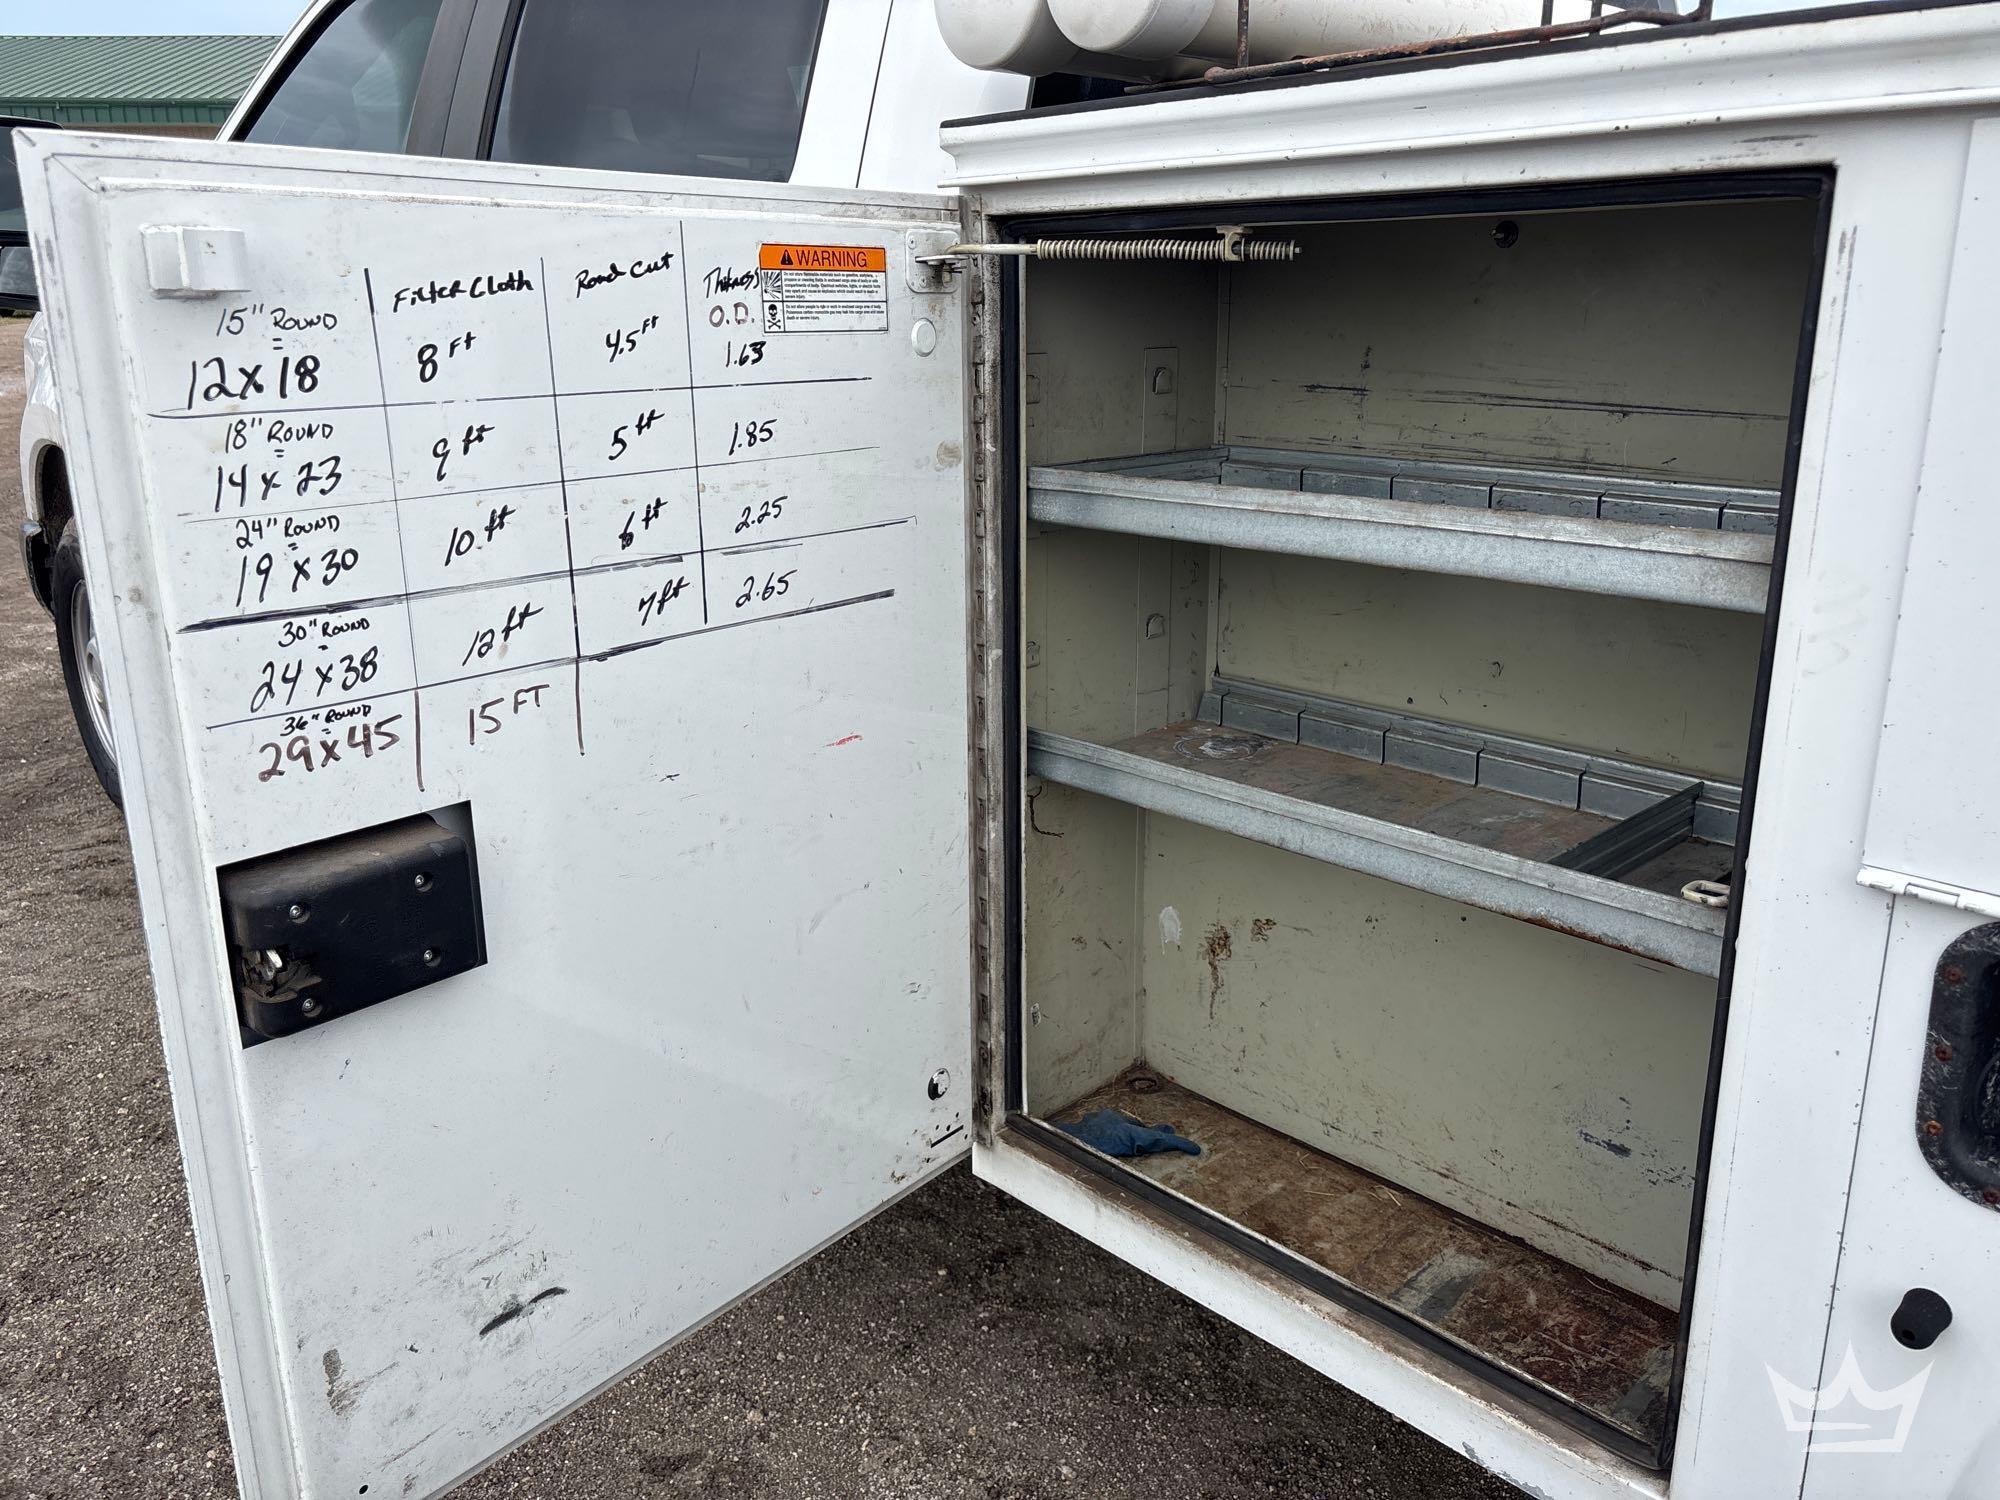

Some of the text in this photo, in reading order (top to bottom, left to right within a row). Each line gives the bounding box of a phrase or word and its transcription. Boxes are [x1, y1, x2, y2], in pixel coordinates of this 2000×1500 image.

[796, 249, 867, 268] WARNING
[709, 302, 755, 327] O.D.
[418, 344, 438, 383] 8
[608, 426, 628, 460] 5
[729, 419, 779, 457] 1.85
[432, 438, 451, 482] 9
[215, 464, 247, 513] 14
[297, 456, 342, 496] 23
[735, 496, 788, 534] 2.25
[445, 527, 474, 567] 10
[236, 553, 273, 607] 19
[321, 548, 358, 586] 30
[735, 569, 799, 609] 2.65
[462, 628, 495, 666] 12
[250, 659, 303, 714] 24
[340, 646, 378, 691] 38
[470, 684, 550, 746] 15 FT
